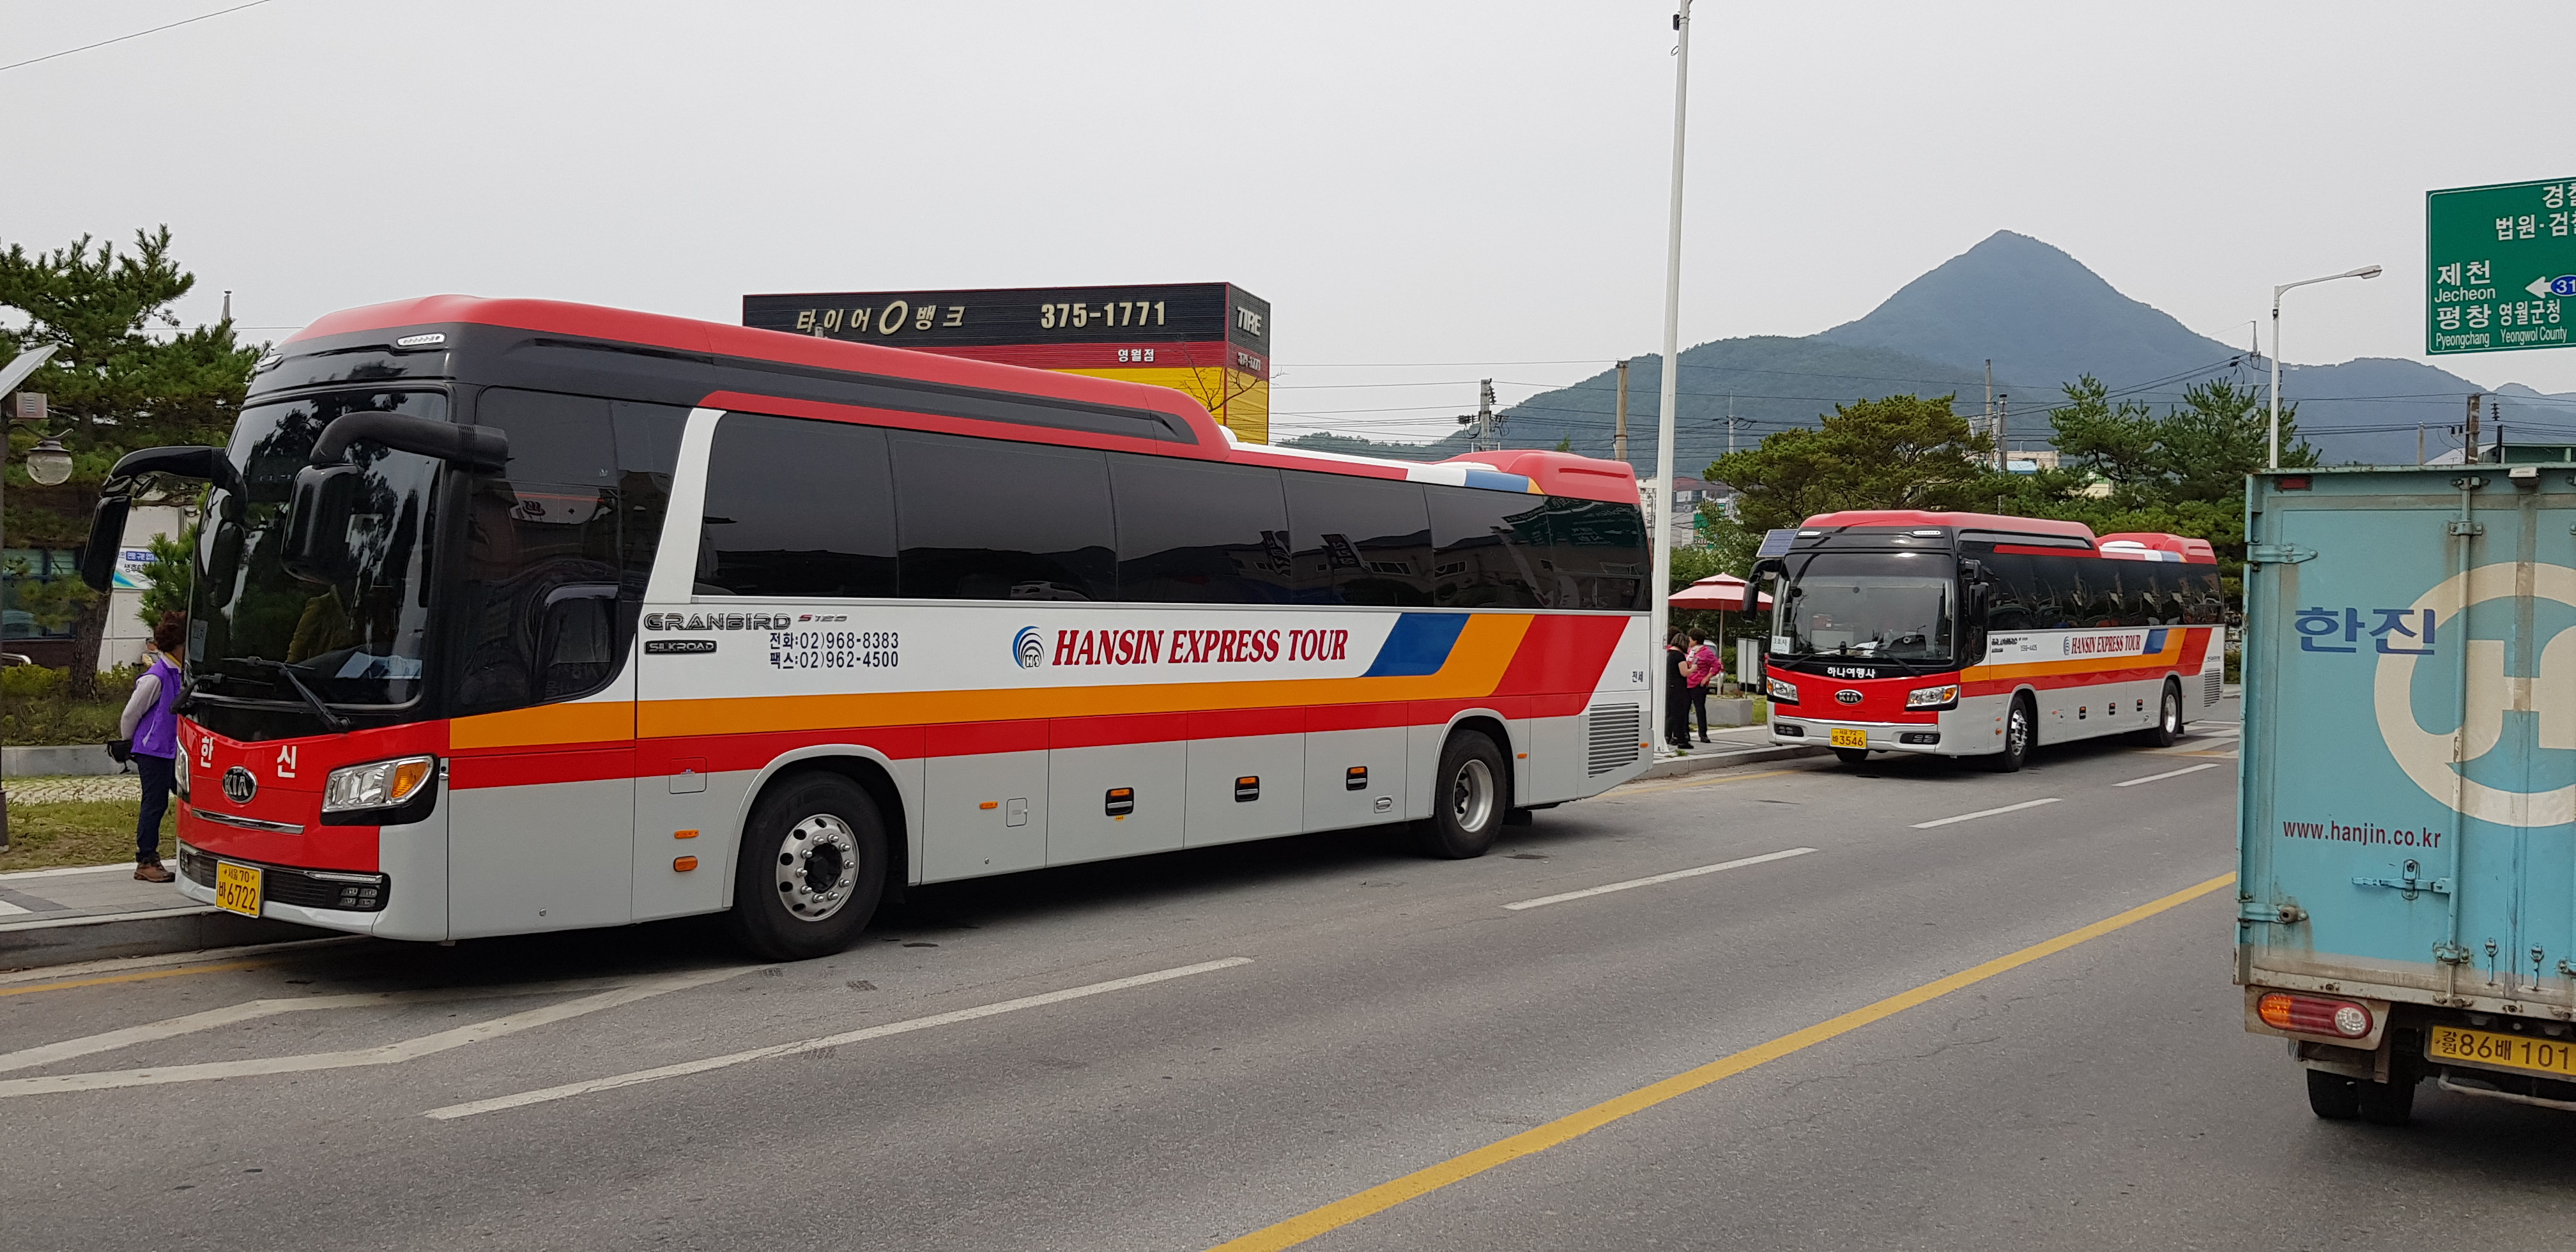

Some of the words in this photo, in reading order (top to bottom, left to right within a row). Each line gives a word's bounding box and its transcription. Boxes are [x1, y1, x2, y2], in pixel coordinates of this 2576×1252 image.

[2496, 211, 2576, 241] 법원·검
[2437, 260, 2491, 286] 제천
[2434, 287, 2496, 303] Jecheon
[2556, 279, 2576, 293] 31
[1041, 301, 1165, 329] 375-1771
[1237, 306, 1262, 337] TIRE
[2436, 303, 2492, 330] 평창
[2499, 298, 2561, 326] 영월군청
[2435, 331, 2490, 350] Pyeongchang
[2500, 328, 2538, 346] Yeongwol
[2539, 326, 2568, 344] County
[1117, 349, 1154, 363] 영월점
[643, 613, 792, 631] GRANBIRD
[2295, 607, 2435, 655] 한진
[648, 641, 715, 652] SILKROAD
[1052, 629, 1165, 666] HANSIN
[1168, 629, 1280, 664] EXPRESS
[1288, 629, 1349, 661] TOUR
[2071, 637, 2096, 654] HANSIN
[2097, 636, 2124, 653] EXPRESS
[2125, 634, 2141, 651] TOUR
[1632, 671, 1643, 682] 전세
[1827, 666, 1876, 678] 하나여행사
[1839, 692, 1858, 702] KIA
[224, 774, 249, 797] KIA
[2282, 820, 2441, 848] www.hanjin.co.kr
